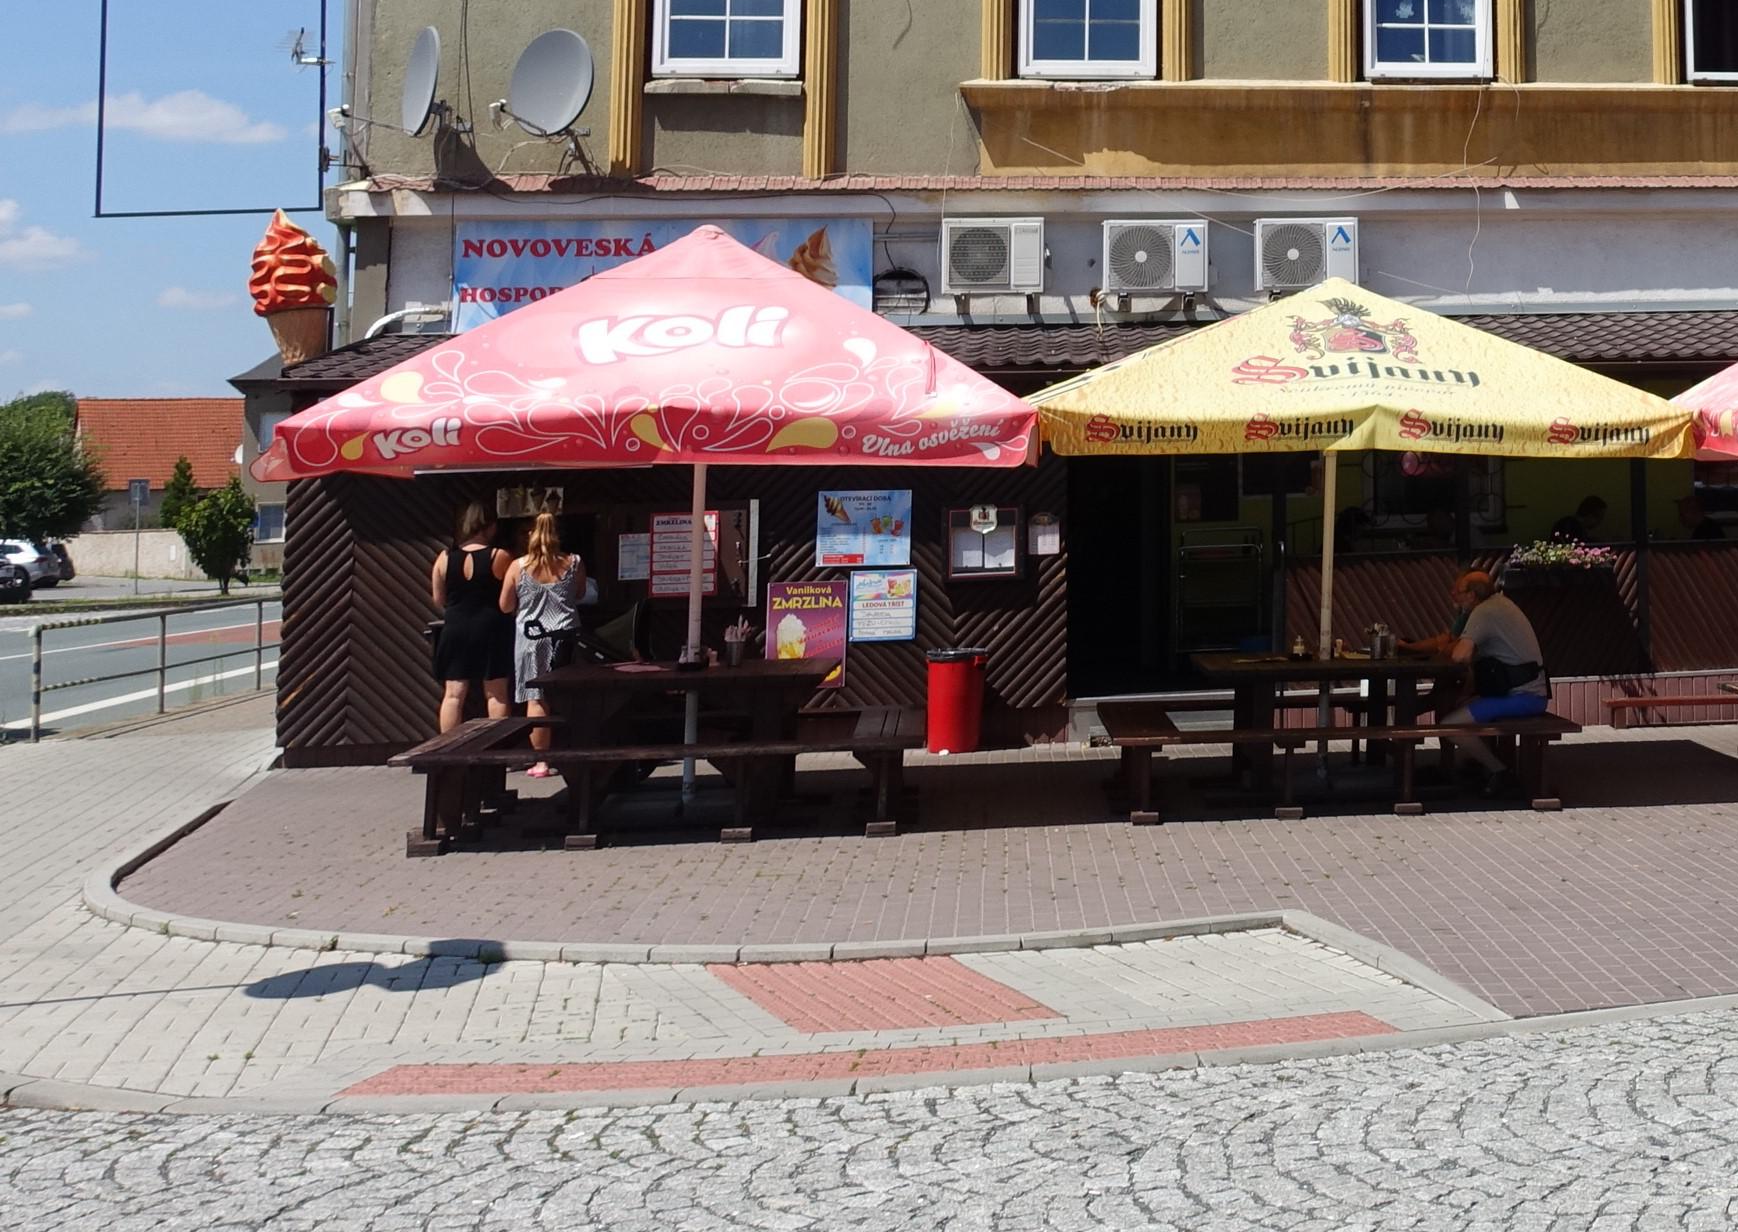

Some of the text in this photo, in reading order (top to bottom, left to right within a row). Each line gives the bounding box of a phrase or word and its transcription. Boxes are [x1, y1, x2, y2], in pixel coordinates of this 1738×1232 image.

[462, 233, 657, 258] NOVOVESKÁ
[1231, 355, 1480, 388] Svijany
[373, 417, 462, 460] Koli
[862, 417, 1005, 457] Vlna osvěžení
[1086, 413, 1198, 444] Svijany
[1244, 412, 1354, 441] Svijany
[1399, 408, 1504, 443] Svijany
[1547, 416, 1651, 446] Svijany
[772, 596, 843, 610] ZMRZLINA
[786, 585, 832, 595] Vanilková
